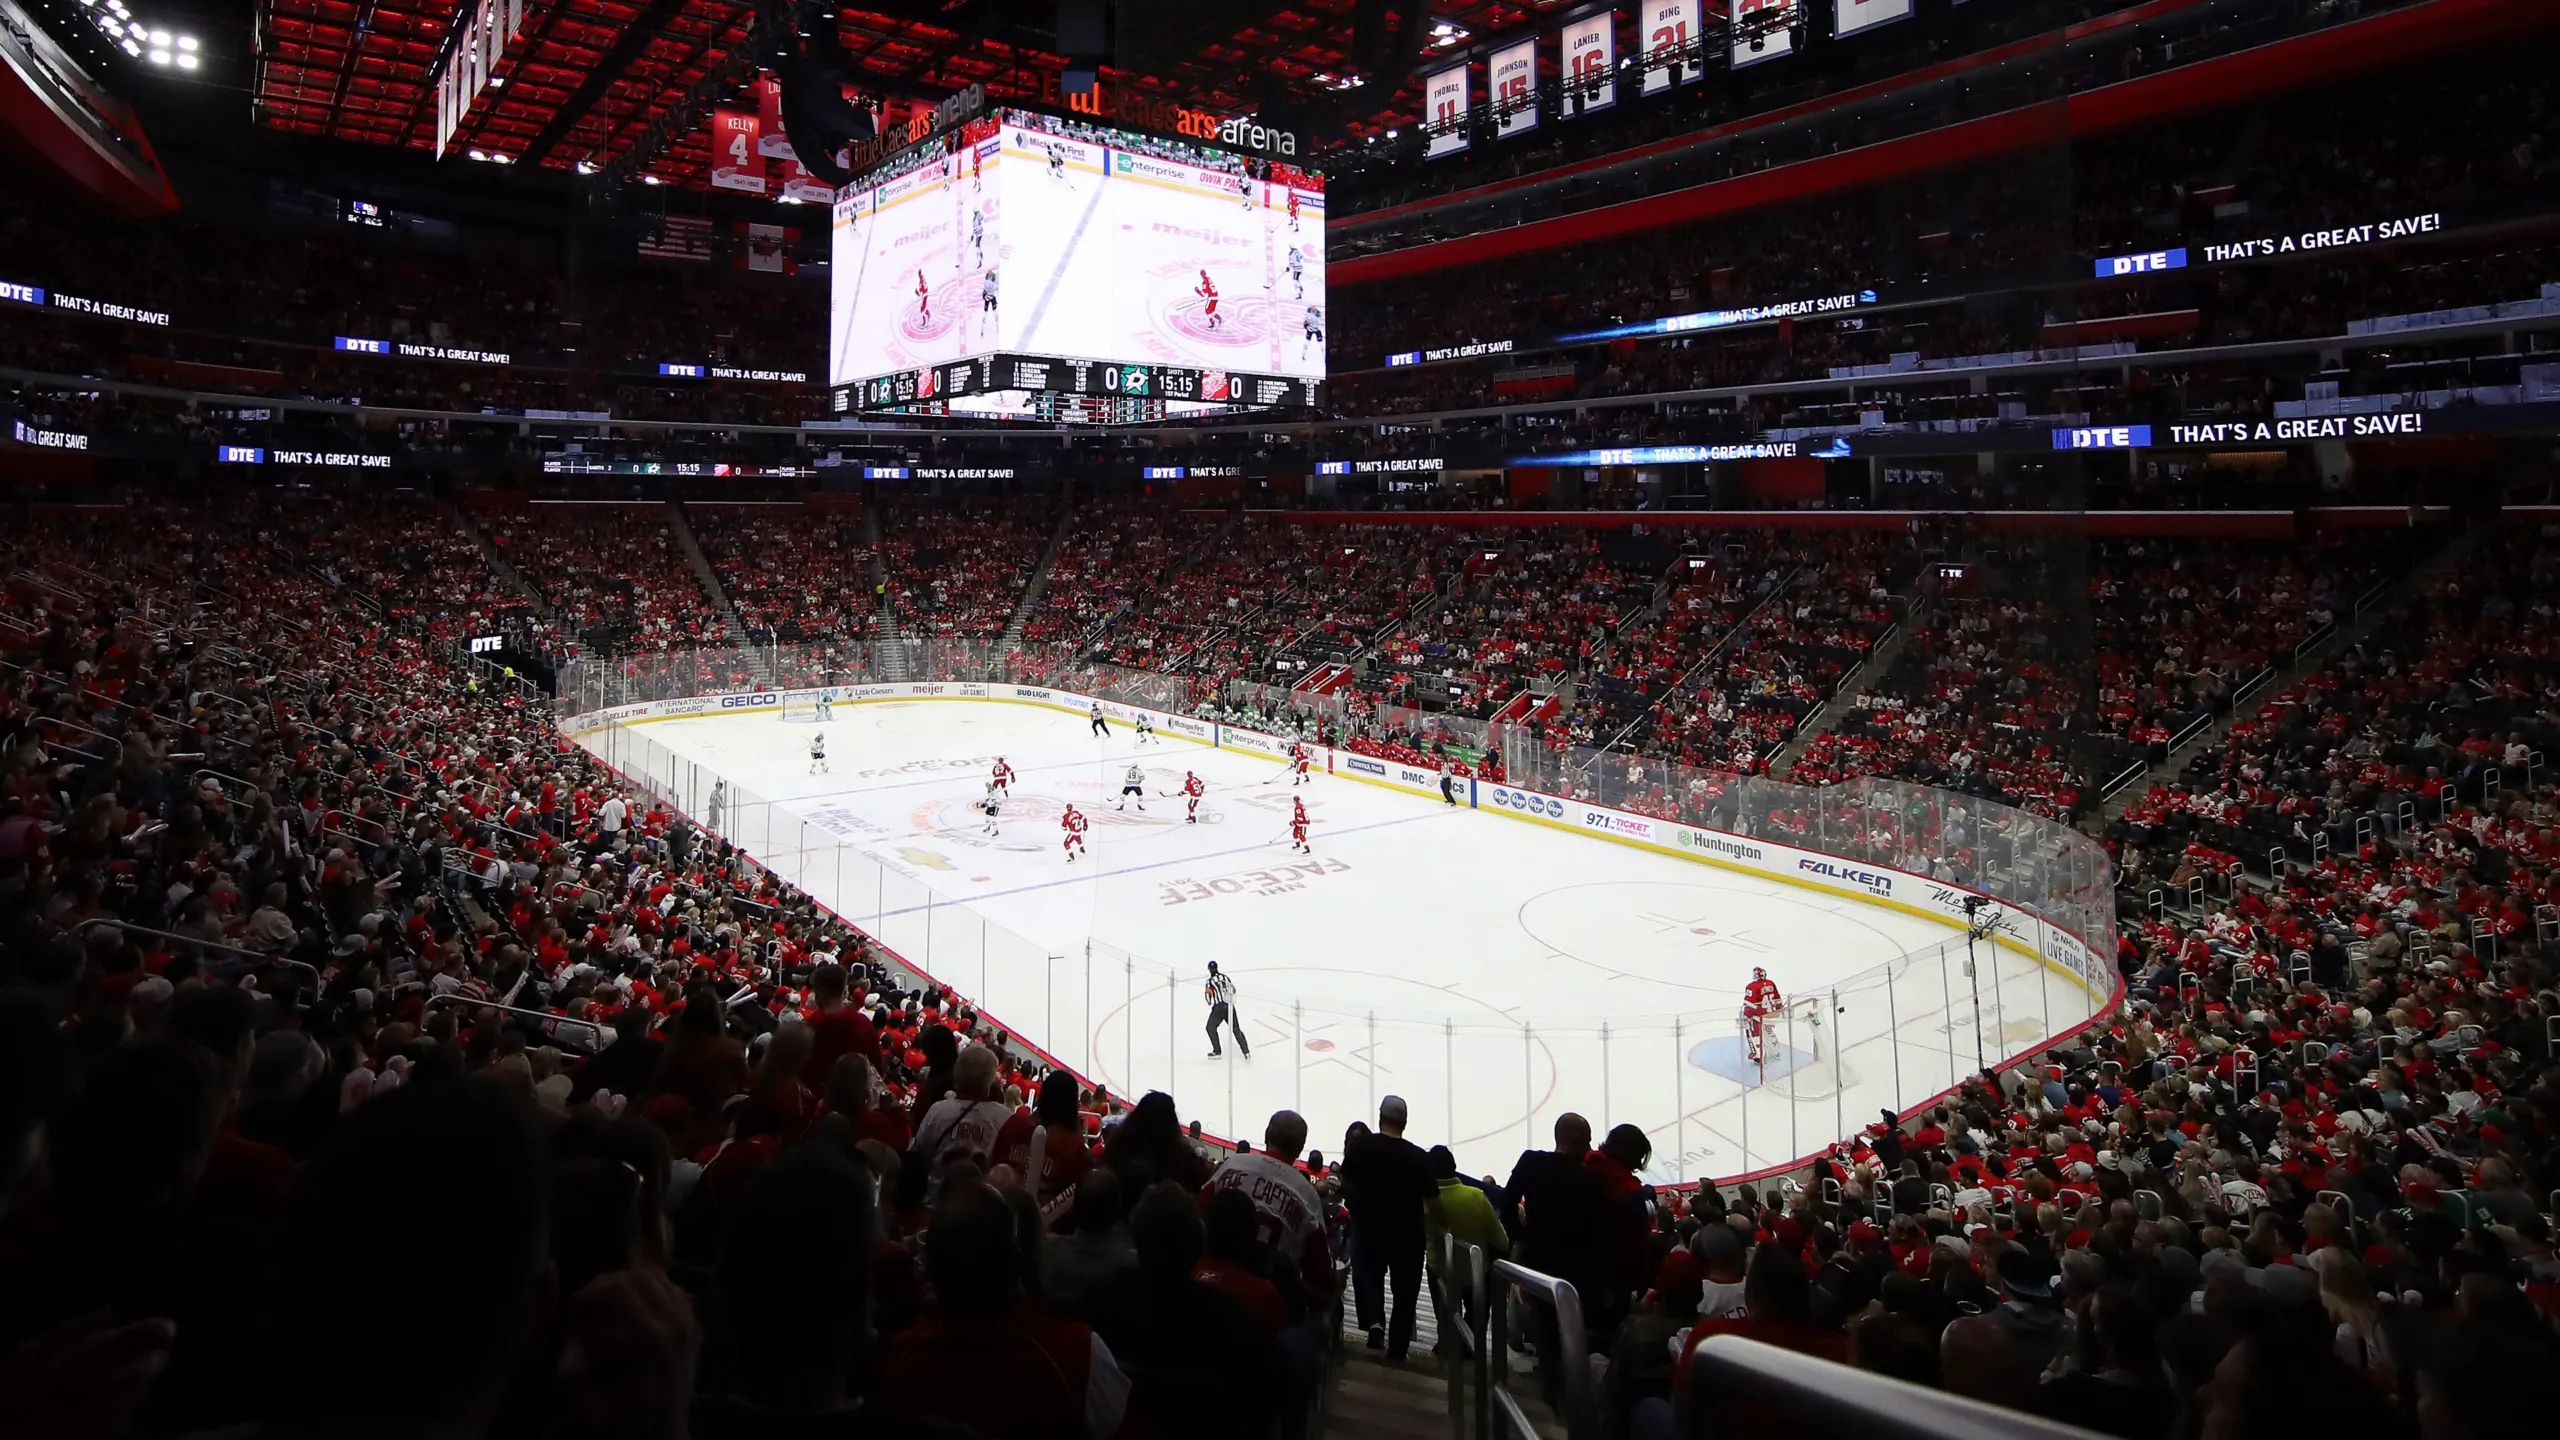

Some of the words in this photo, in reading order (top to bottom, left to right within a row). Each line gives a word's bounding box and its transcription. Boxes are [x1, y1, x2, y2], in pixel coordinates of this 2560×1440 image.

[1659, 5, 1680, 22] BING
[1573, 33, 1600, 50] LANIER
[1497, 59, 1528, 79] JOHNSON
[1433, 83, 1460, 99] THOMAS
[932, 82, 986, 129] arena
[1118, 89, 1217, 141] Caesars
[1221, 117, 1297, 157] arena
[1438, 99, 1456, 131] 11
[728, 117, 754, 133] KELLY
[729, 133, 748, 166] 4
[1199, 172, 1222, 187] QWIK
[894, 221, 949, 248] meijer
[1152, 222, 1254, 248] meijer
[2203, 238, 2274, 262] THAT'S
[2279, 236, 2296, 253] A
[2301, 224, 2373, 249] GREAT
[2378, 213, 2440, 239] SAVE!
[2113, 253, 2167, 275] DTE
[0, 282, 33, 302] DTE
[54, 294, 90, 311] THAT'S
[92, 301, 101, 314] A
[103, 304, 135, 319] GREAT
[137, 310, 169, 326] SAVE!
[1719, 307, 1759, 323] THAT'S
[1761, 307, 1770, 319] A
[1773, 300, 1814, 317] GREAT
[1816, 295, 1856, 311] SAVE!
[1666, 316, 1698, 331] DTE
[347, 339, 379, 353] DTE
[399, 344, 435, 357] THAT'S
[437, 347, 445, 358] A
[447, 349, 480, 361] GREAT
[482, 353, 510, 365] SAVE!
[1426, 349, 1451, 361] THAT'S
[1452, 348, 1460, 358] A
[1461, 344, 1487, 357] GREAT
[1488, 340, 1513, 353] SAVE!
[1392, 352, 1413, 366] DTE
[669, 365, 696, 376] DTE
[712, 368, 741, 378] THAT'S
[743, 370, 751, 379] A
[752, 371, 780, 381] GREAT
[781, 373, 806, 382] SAVE!
[1105, 366, 1119, 391] 0
[1152, 366, 1158, 375] 2
[1166, 368, 1184, 376] SHOTS
[1194, 370, 1200, 378] 2
[895, 379, 914, 395] 15:15
[933, 370, 942, 393] 0
[1158, 375, 1194, 392] 15:15
[1230, 377, 1243, 399] 0
[870, 382, 878, 403] 0
[2170, 423, 2248, 443] THAT'S
[2254, 422, 2272, 440] A
[2276, 418, 2347, 439] GREAT
[2353, 413, 2422, 435] SAVE!
[39, 430, 65, 447] GREAT
[66, 433, 88, 450] SAVE!
[2073, 428, 2130, 448] DTE
[229, 448, 255, 462] DTE
[274, 451, 312, 465] THAT'S
[314, 453, 324, 465] A
[326, 454, 360, 467] GREAT
[362, 456, 390, 468] SAVE!
[1600, 450, 1632, 464] DTE
[1654, 447, 1696, 460] THAT'S
[1698, 447, 1708, 460] A
[1710, 445, 1754, 460] GREAT
[1756, 443, 1797, 458] SAVE!
[632, 464, 639, 473] 0
[676, 463, 700, 473] 15:15
[735, 467, 741, 476] 0
[873, 468, 900, 479] DTE
[916, 469, 947, 478] THAT'S
[949, 469, 956, 478] A
[958, 469, 987, 478] GREAT
[988, 469, 1014, 478] SAVE!
[1153, 468, 1177, 479] DTE
[1190, 467, 1217, 477] THAT'S
[1322, 462, 1343, 475] DTE
[1356, 462, 1380, 473] THAT'S
[1381, 461, 1390, 472] A
[1391, 461, 1418, 472] GREAT
[1419, 459, 1444, 471] SAVE!
[471, 636, 502, 653] DTE
[854, 688, 870, 698] Little
[870, 687, 894, 697] Caesars
[912, 684, 945, 697] meijer
[1017, 688, 1032, 698] BUD
[1032, 689, 1051, 699] LIGHT
[655, 697, 715, 709] INTERNATIONAL
[721, 693, 777, 709] GEICO
[609, 710, 629, 720] BELLE
[632, 707, 648, 716] TIRE
[1174, 720, 1194, 731] Michigan
[1194, 724, 1205, 733] First
[1401, 770, 1425, 785] DMC
[1586, 812, 1610, 829] 97.1
[1615, 818, 1650, 832] TICKET
[1694, 832, 1762, 860] Huntington
[1158, 857, 1352, 906] FACE-OFF
[1799, 858, 1892, 891] FALKEN
[1250, 881, 1306, 897] NHL
[1868, 886, 1891, 897] TIRES
[2047, 941, 2063, 963] LIVE
[951, 1122, 985, 1144] LARKIN
[1662, 1146, 1716, 1171] PURE
